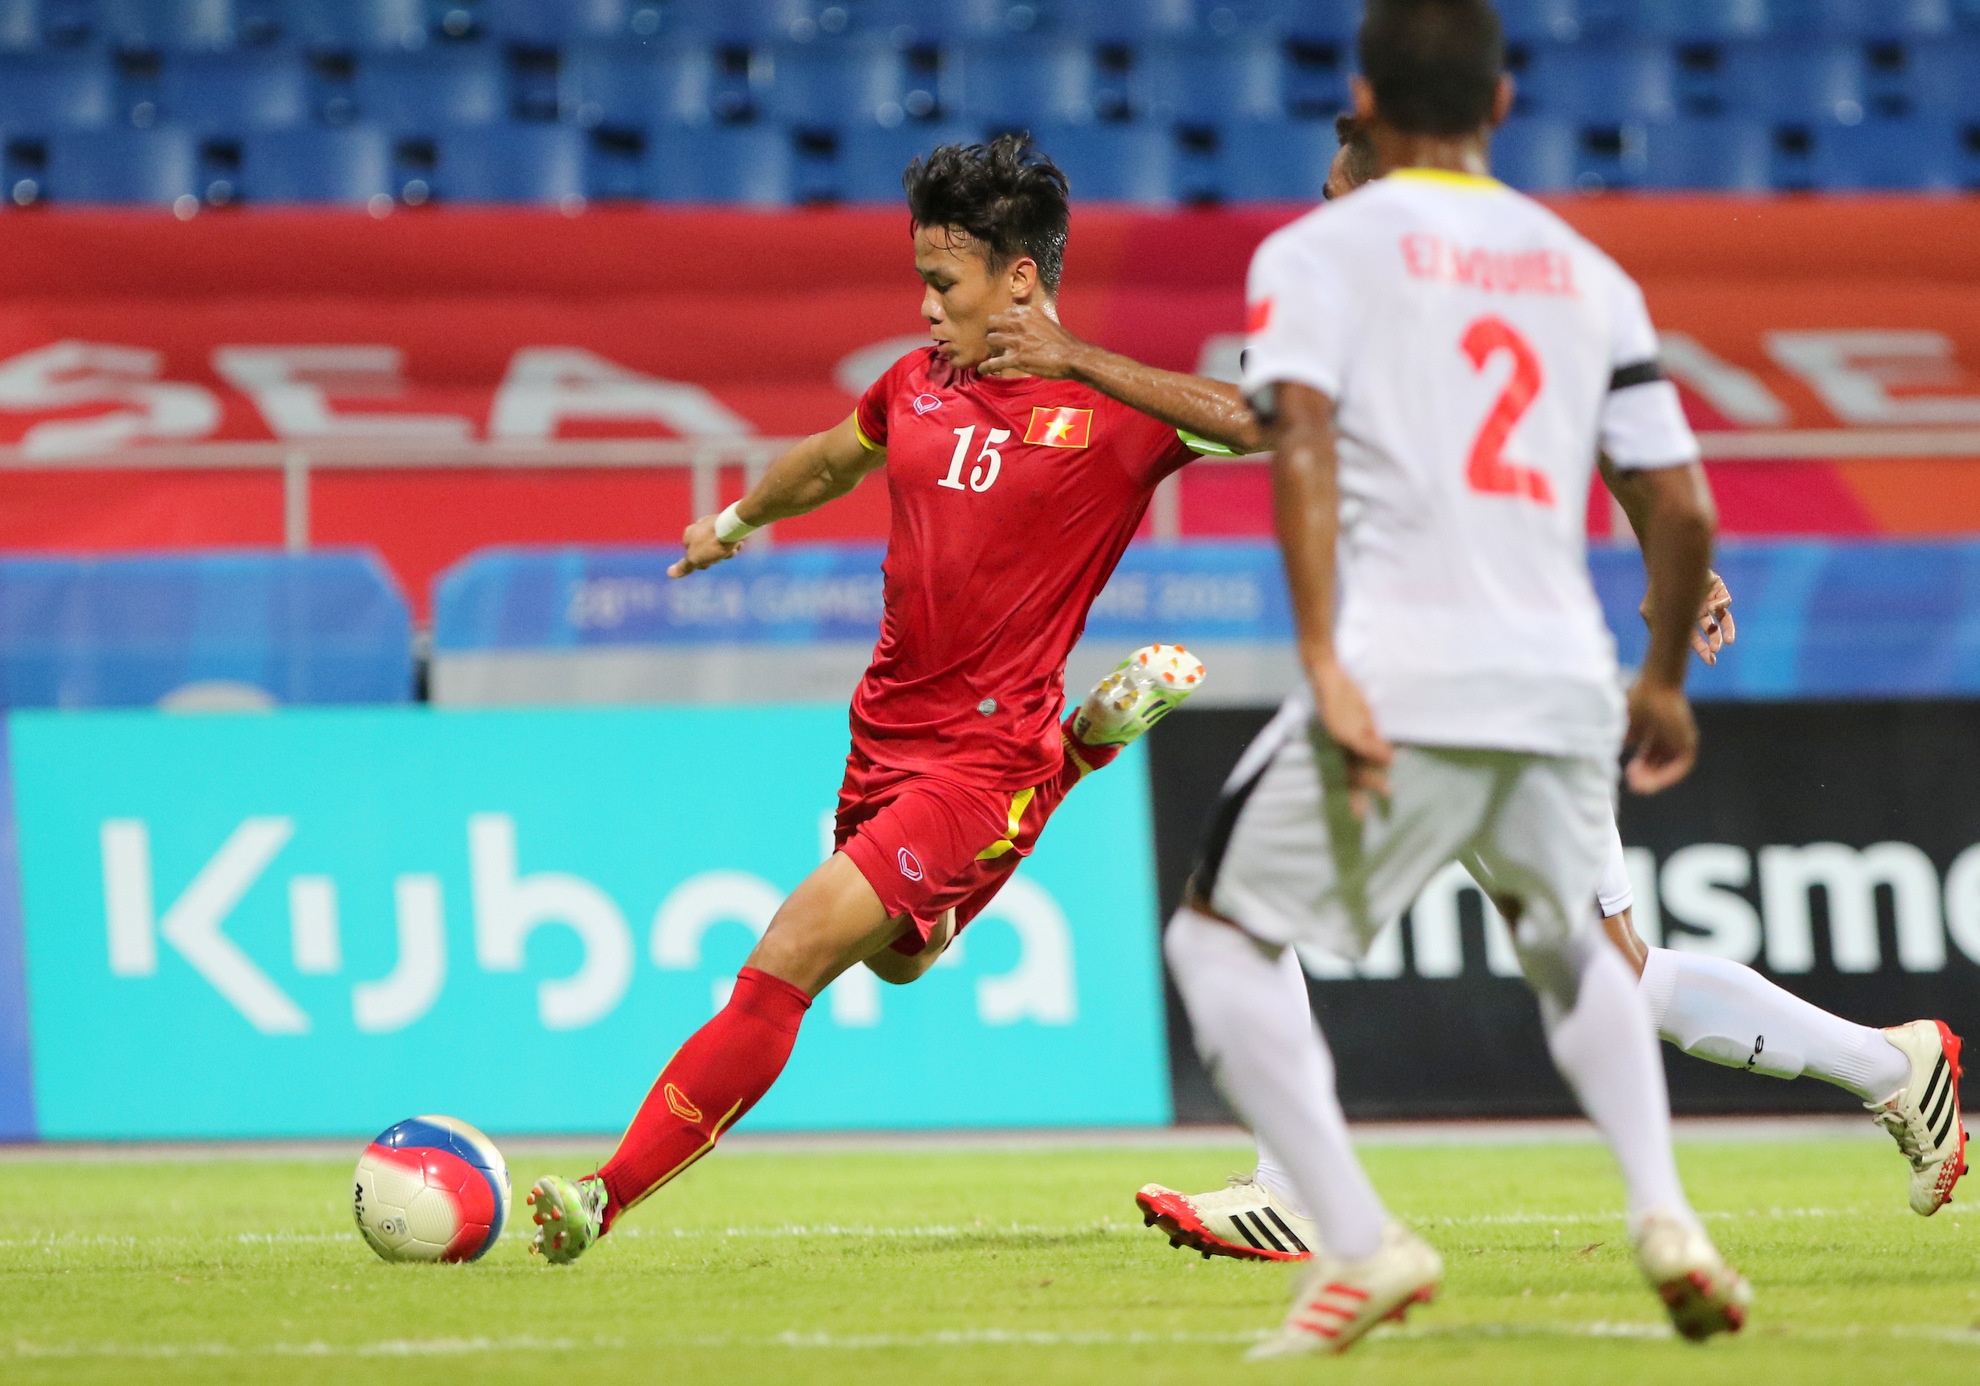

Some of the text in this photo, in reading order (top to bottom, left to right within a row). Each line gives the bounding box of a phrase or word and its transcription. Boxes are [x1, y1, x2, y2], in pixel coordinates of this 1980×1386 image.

[0, 339, 757, 459] SEA
[937, 425, 1011, 492] 15
[1460, 313, 1557, 506] 2
